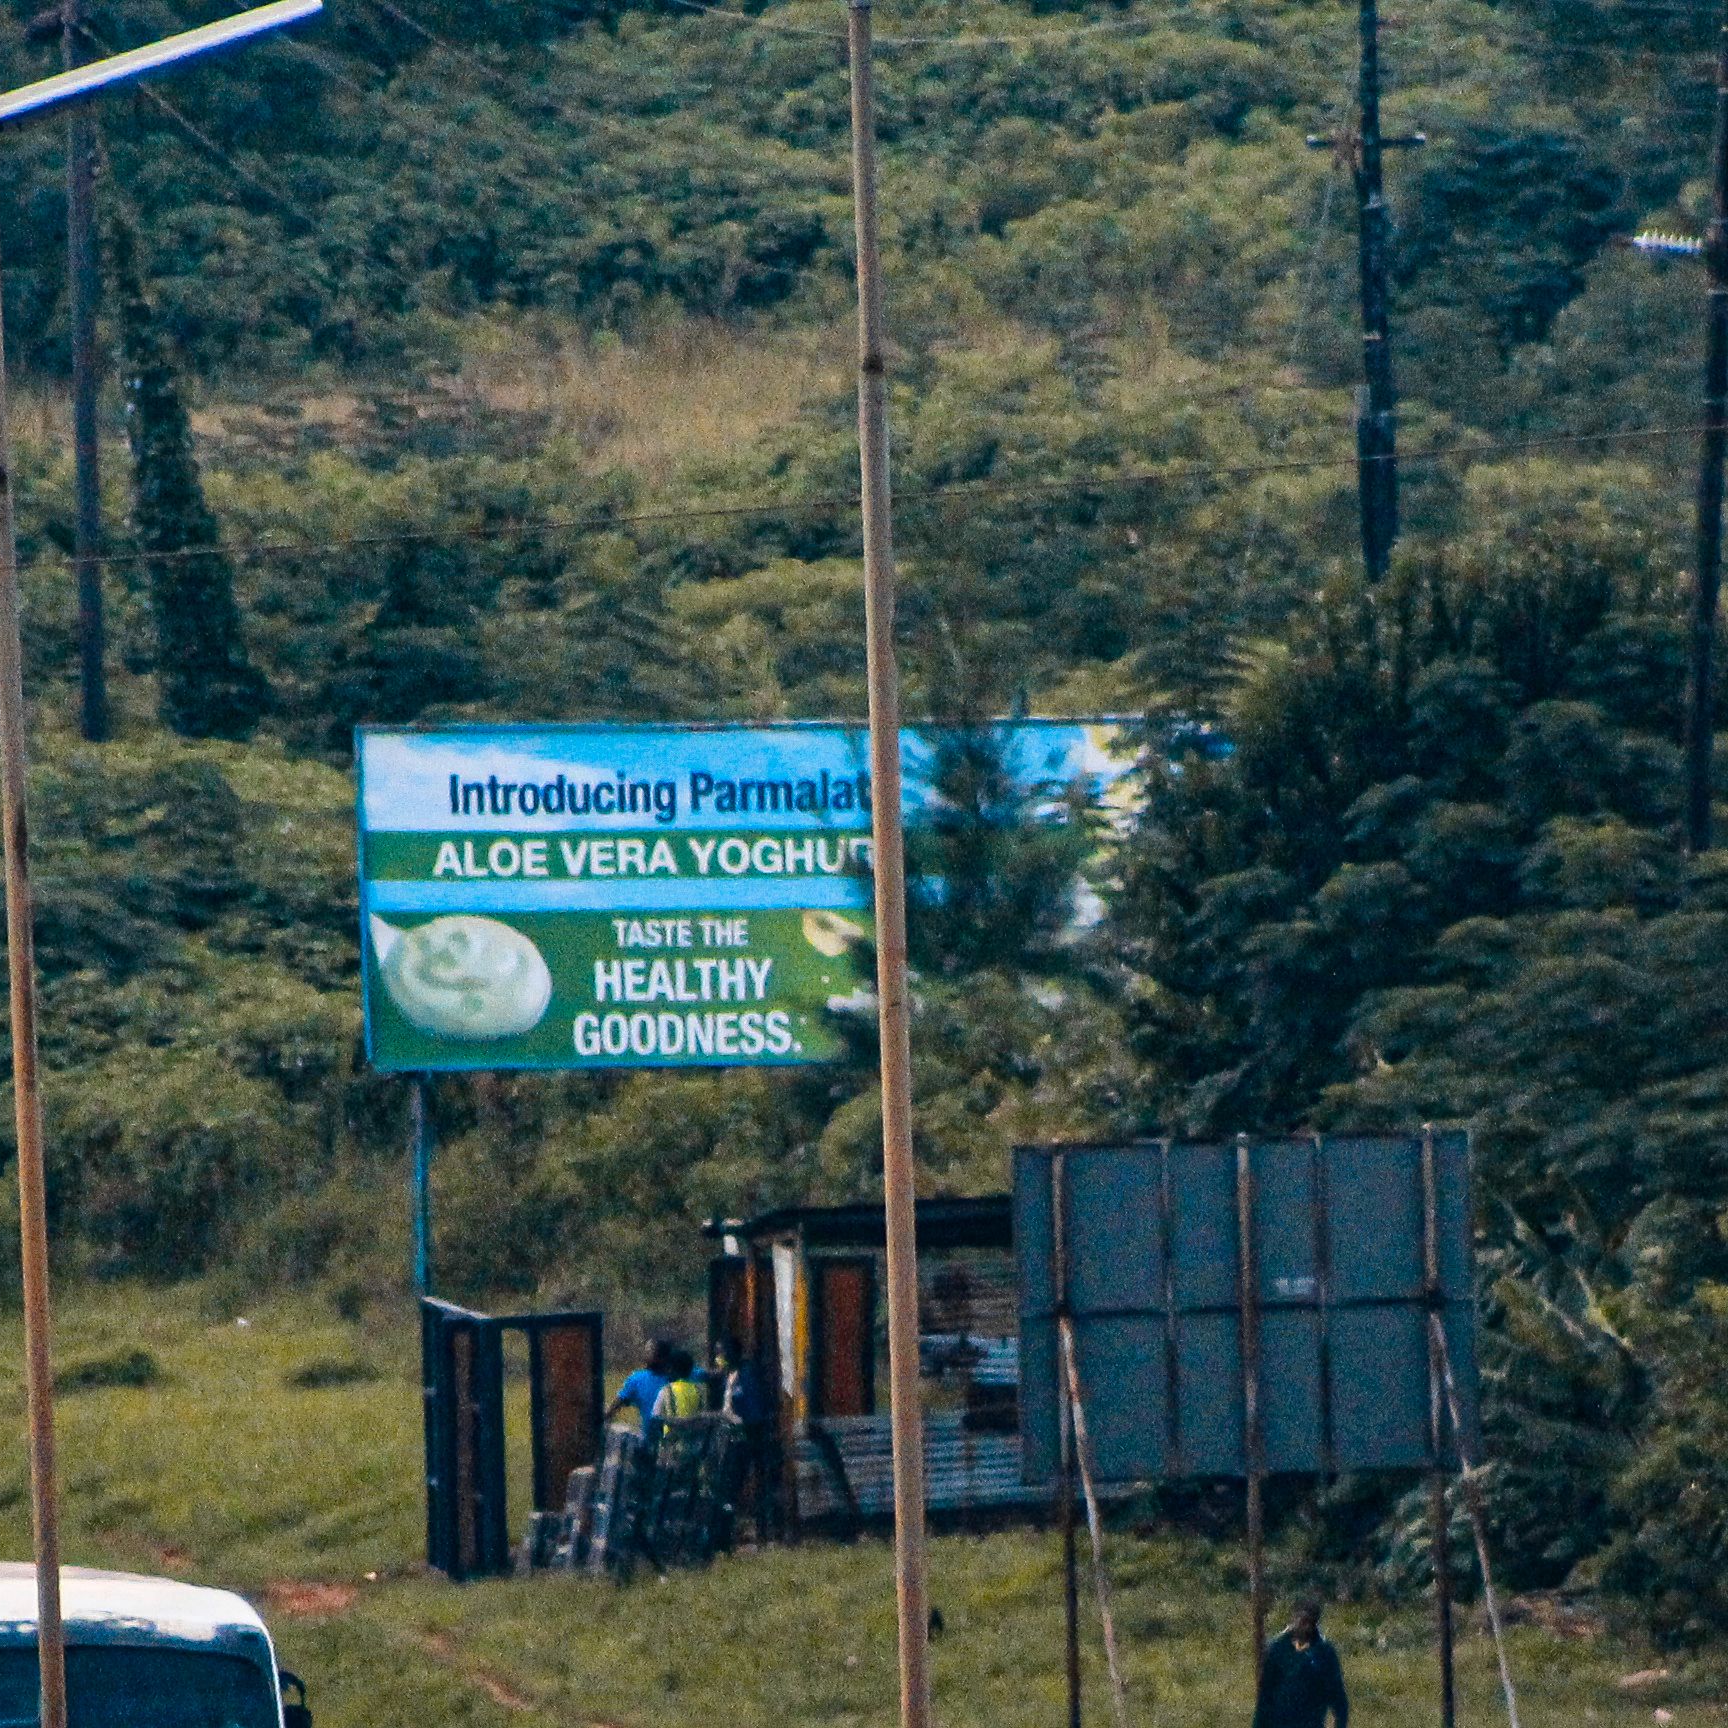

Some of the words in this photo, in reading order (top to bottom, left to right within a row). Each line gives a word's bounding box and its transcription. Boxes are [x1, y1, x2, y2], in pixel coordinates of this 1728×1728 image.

[449, 769, 677, 824] Introducing
[689, 768, 872, 814] Parmalat
[432, 838, 549, 878] ALOE
[560, 838, 679, 877] VERA
[688, 836, 873, 875] YOGHUR
[612, 919, 692, 947] TASTE
[698, 918, 749, 946] THE
[593, 958, 773, 1002] HEALTHY
[573, 1010, 803, 1056] GOODNESS.
